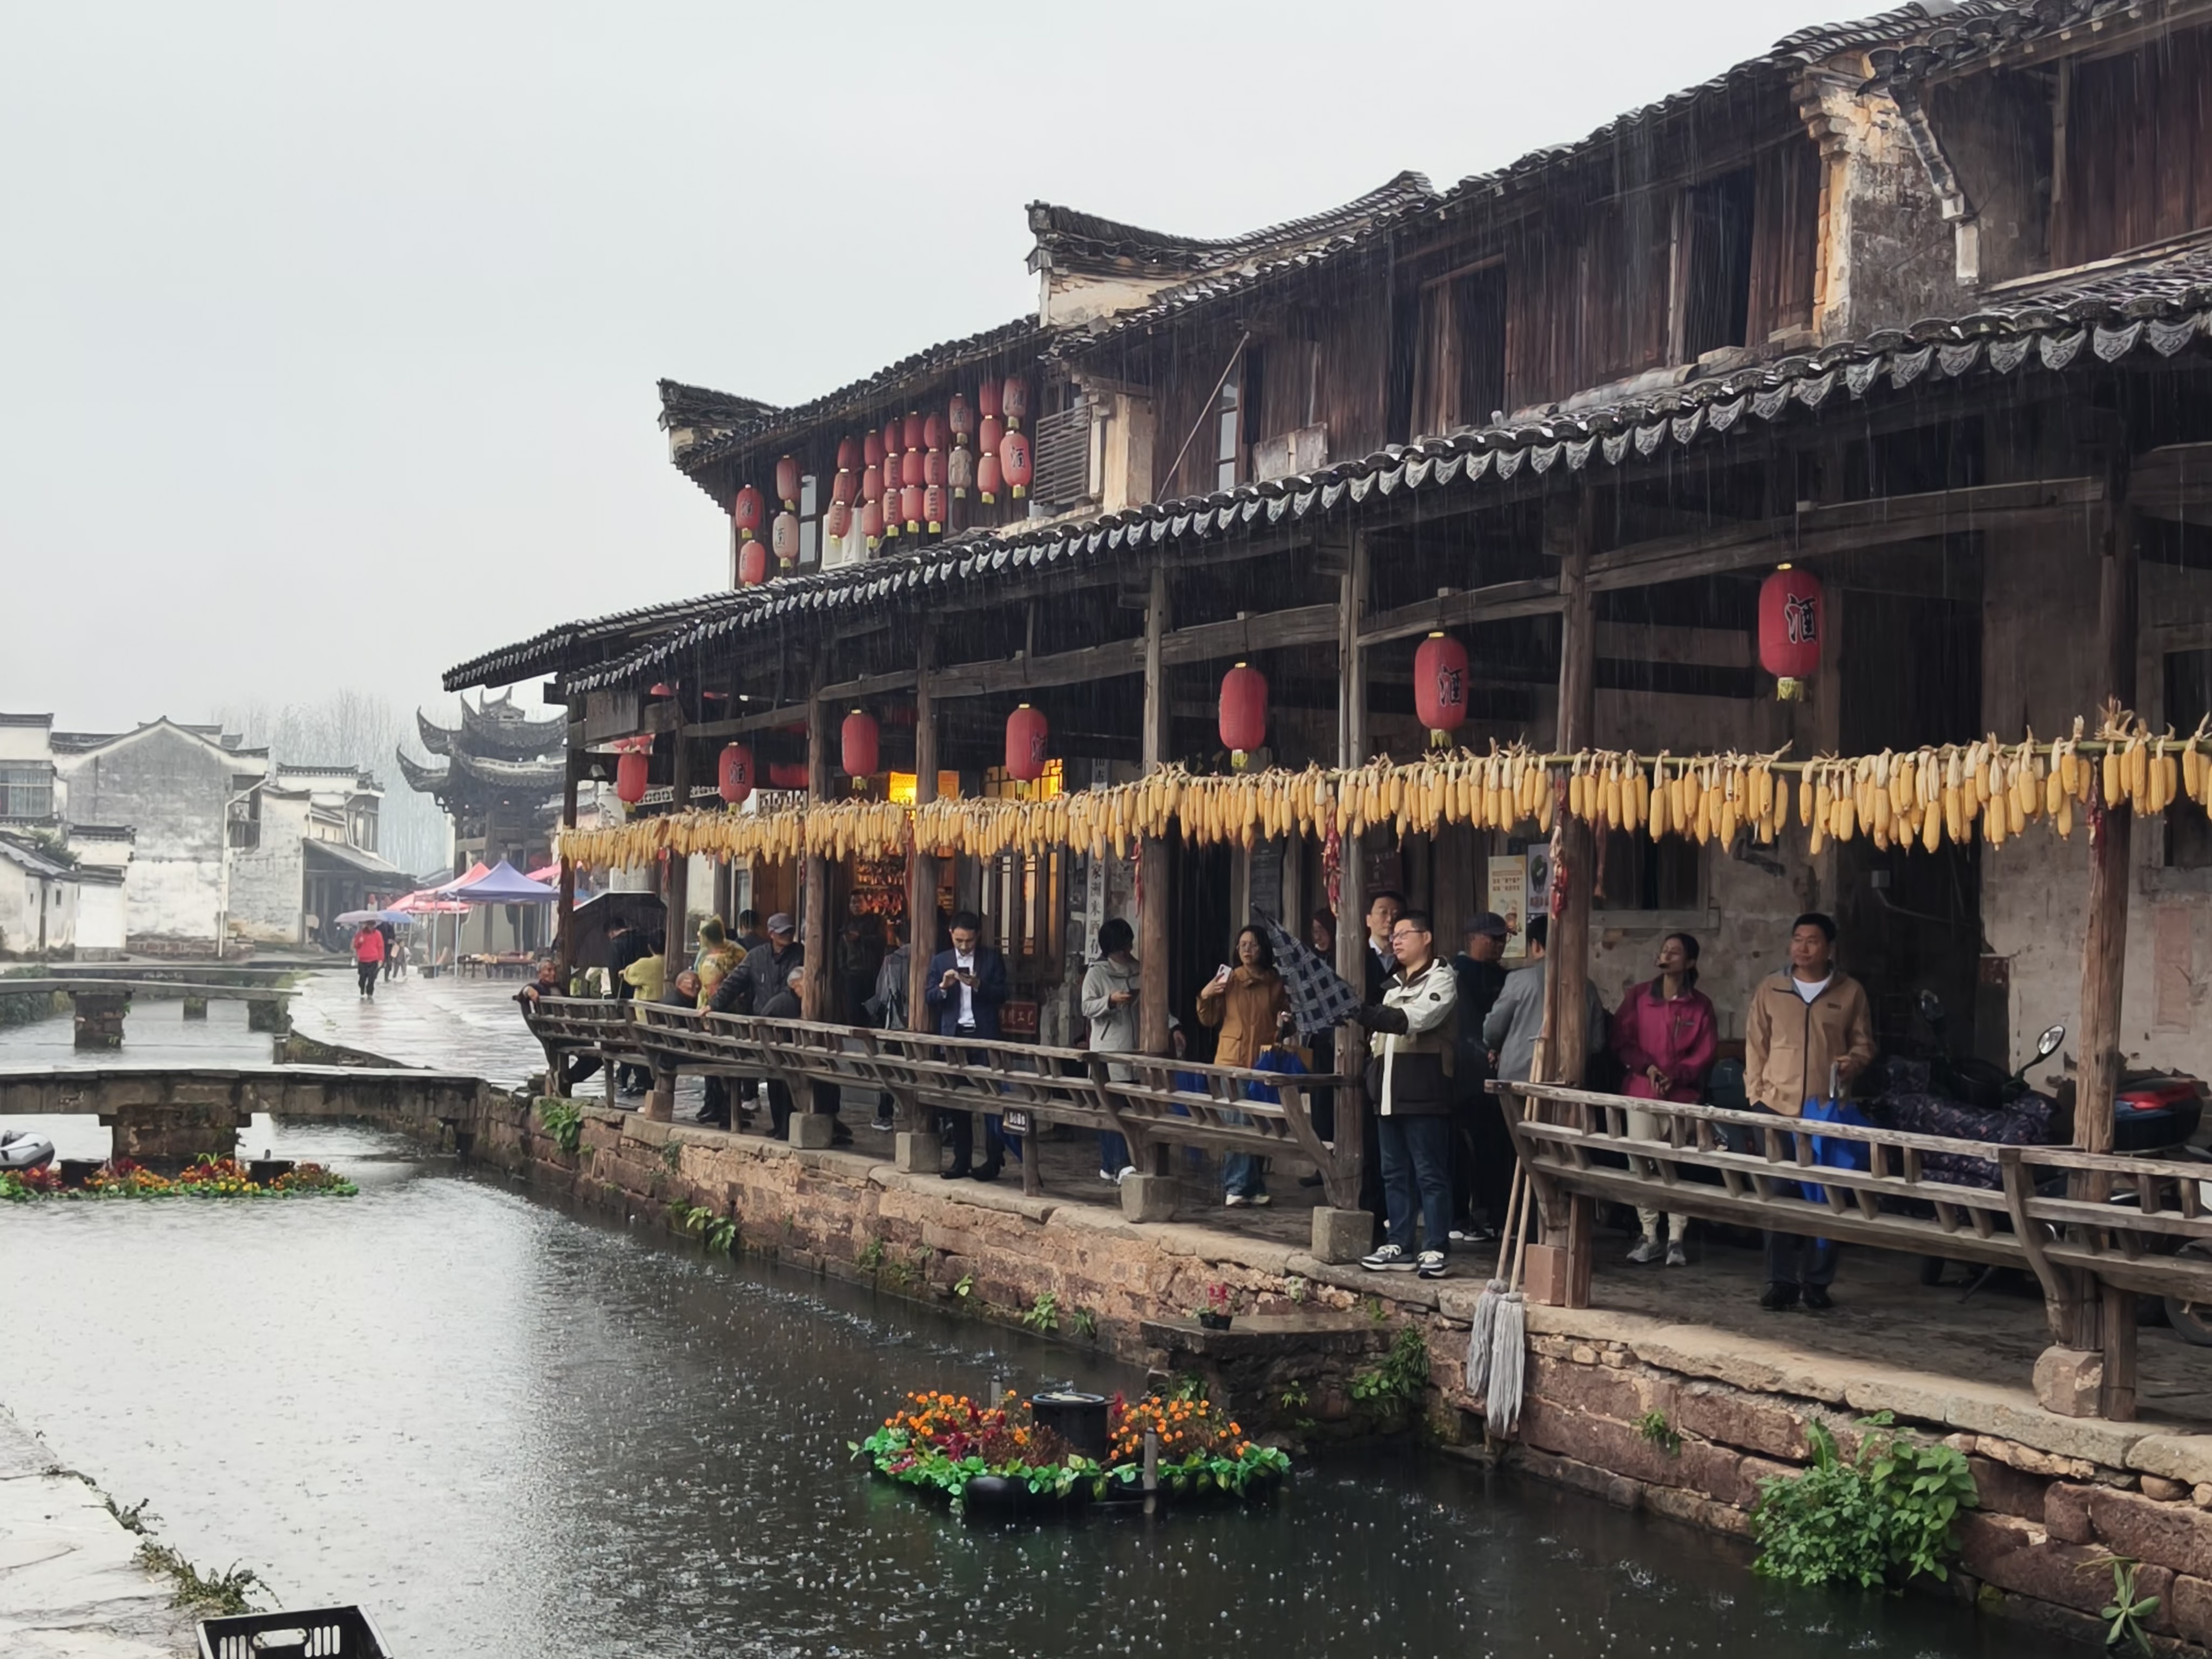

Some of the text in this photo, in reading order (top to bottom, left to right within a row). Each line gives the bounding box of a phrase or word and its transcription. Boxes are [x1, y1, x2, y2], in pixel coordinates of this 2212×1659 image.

[1010, 446, 1025, 470] 酒
[1784, 593, 1818, 644] 酒
[1438, 664, 1462, 707] 酒
[730, 760, 746, 785] 酒
